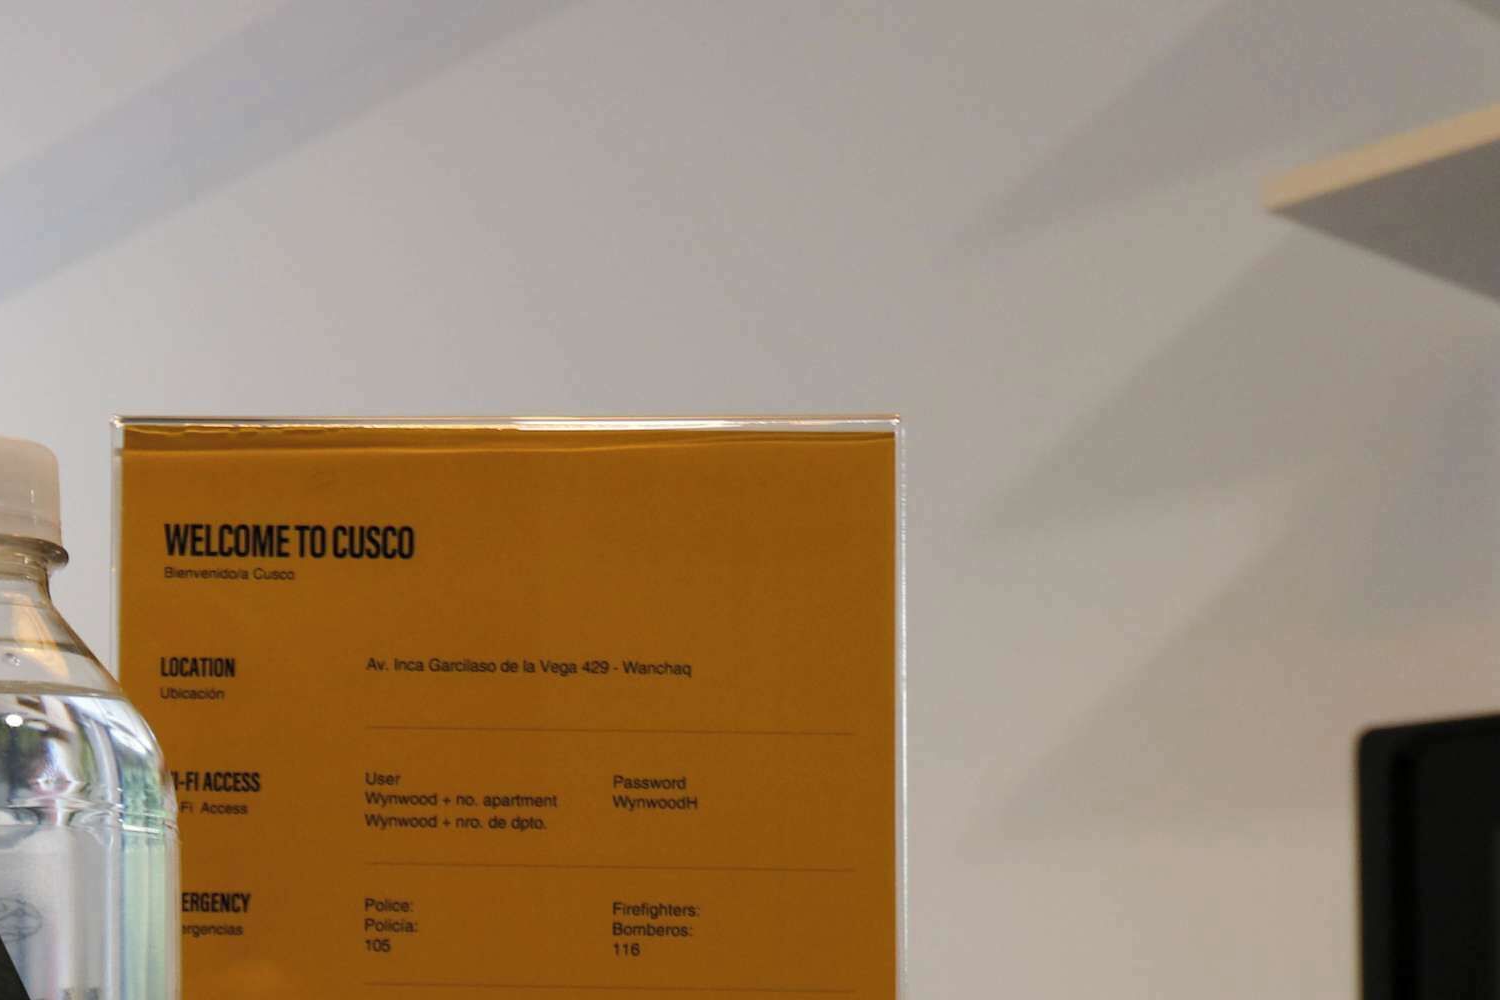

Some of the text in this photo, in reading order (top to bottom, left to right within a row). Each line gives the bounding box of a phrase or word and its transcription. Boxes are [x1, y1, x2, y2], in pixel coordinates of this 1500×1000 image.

[164, 524, 414, 559] WELCOME TO CUSCO
[253, 568, 295, 580] Cusco
[161, 657, 235, 677] LOCATION
[366, 658, 388, 670] Av.
[394, 658, 424, 672] Inca
[428, 658, 497, 673] Garcilaso
[500, 660, 519, 673] de
[523, 660, 536, 673] la
[540, 660, 578, 677] Vega
[582, 660, 609, 674] 429
[623, 661, 692, 678] Wanchaq
[160, 687, 225, 700] Ubicación
[203, 772, 260, 792] ACCESS
[365, 772, 401, 786] User
[613, 775, 686, 790] Password
[365, 792, 557, 809] Wynwood + no. apartment
[200, 802, 248, 815] Access
[364, 814, 546, 832] Wynwood + nro. de dpto.
[181, 892, 251, 913] ERGENCY
[364, 898, 413, 912] Police:
[613, 902, 700, 919] Firefighters:
[612, 922, 692, 937] Bomberos:
[365, 938, 391, 952] 105
[614, 943, 640, 956] 116
